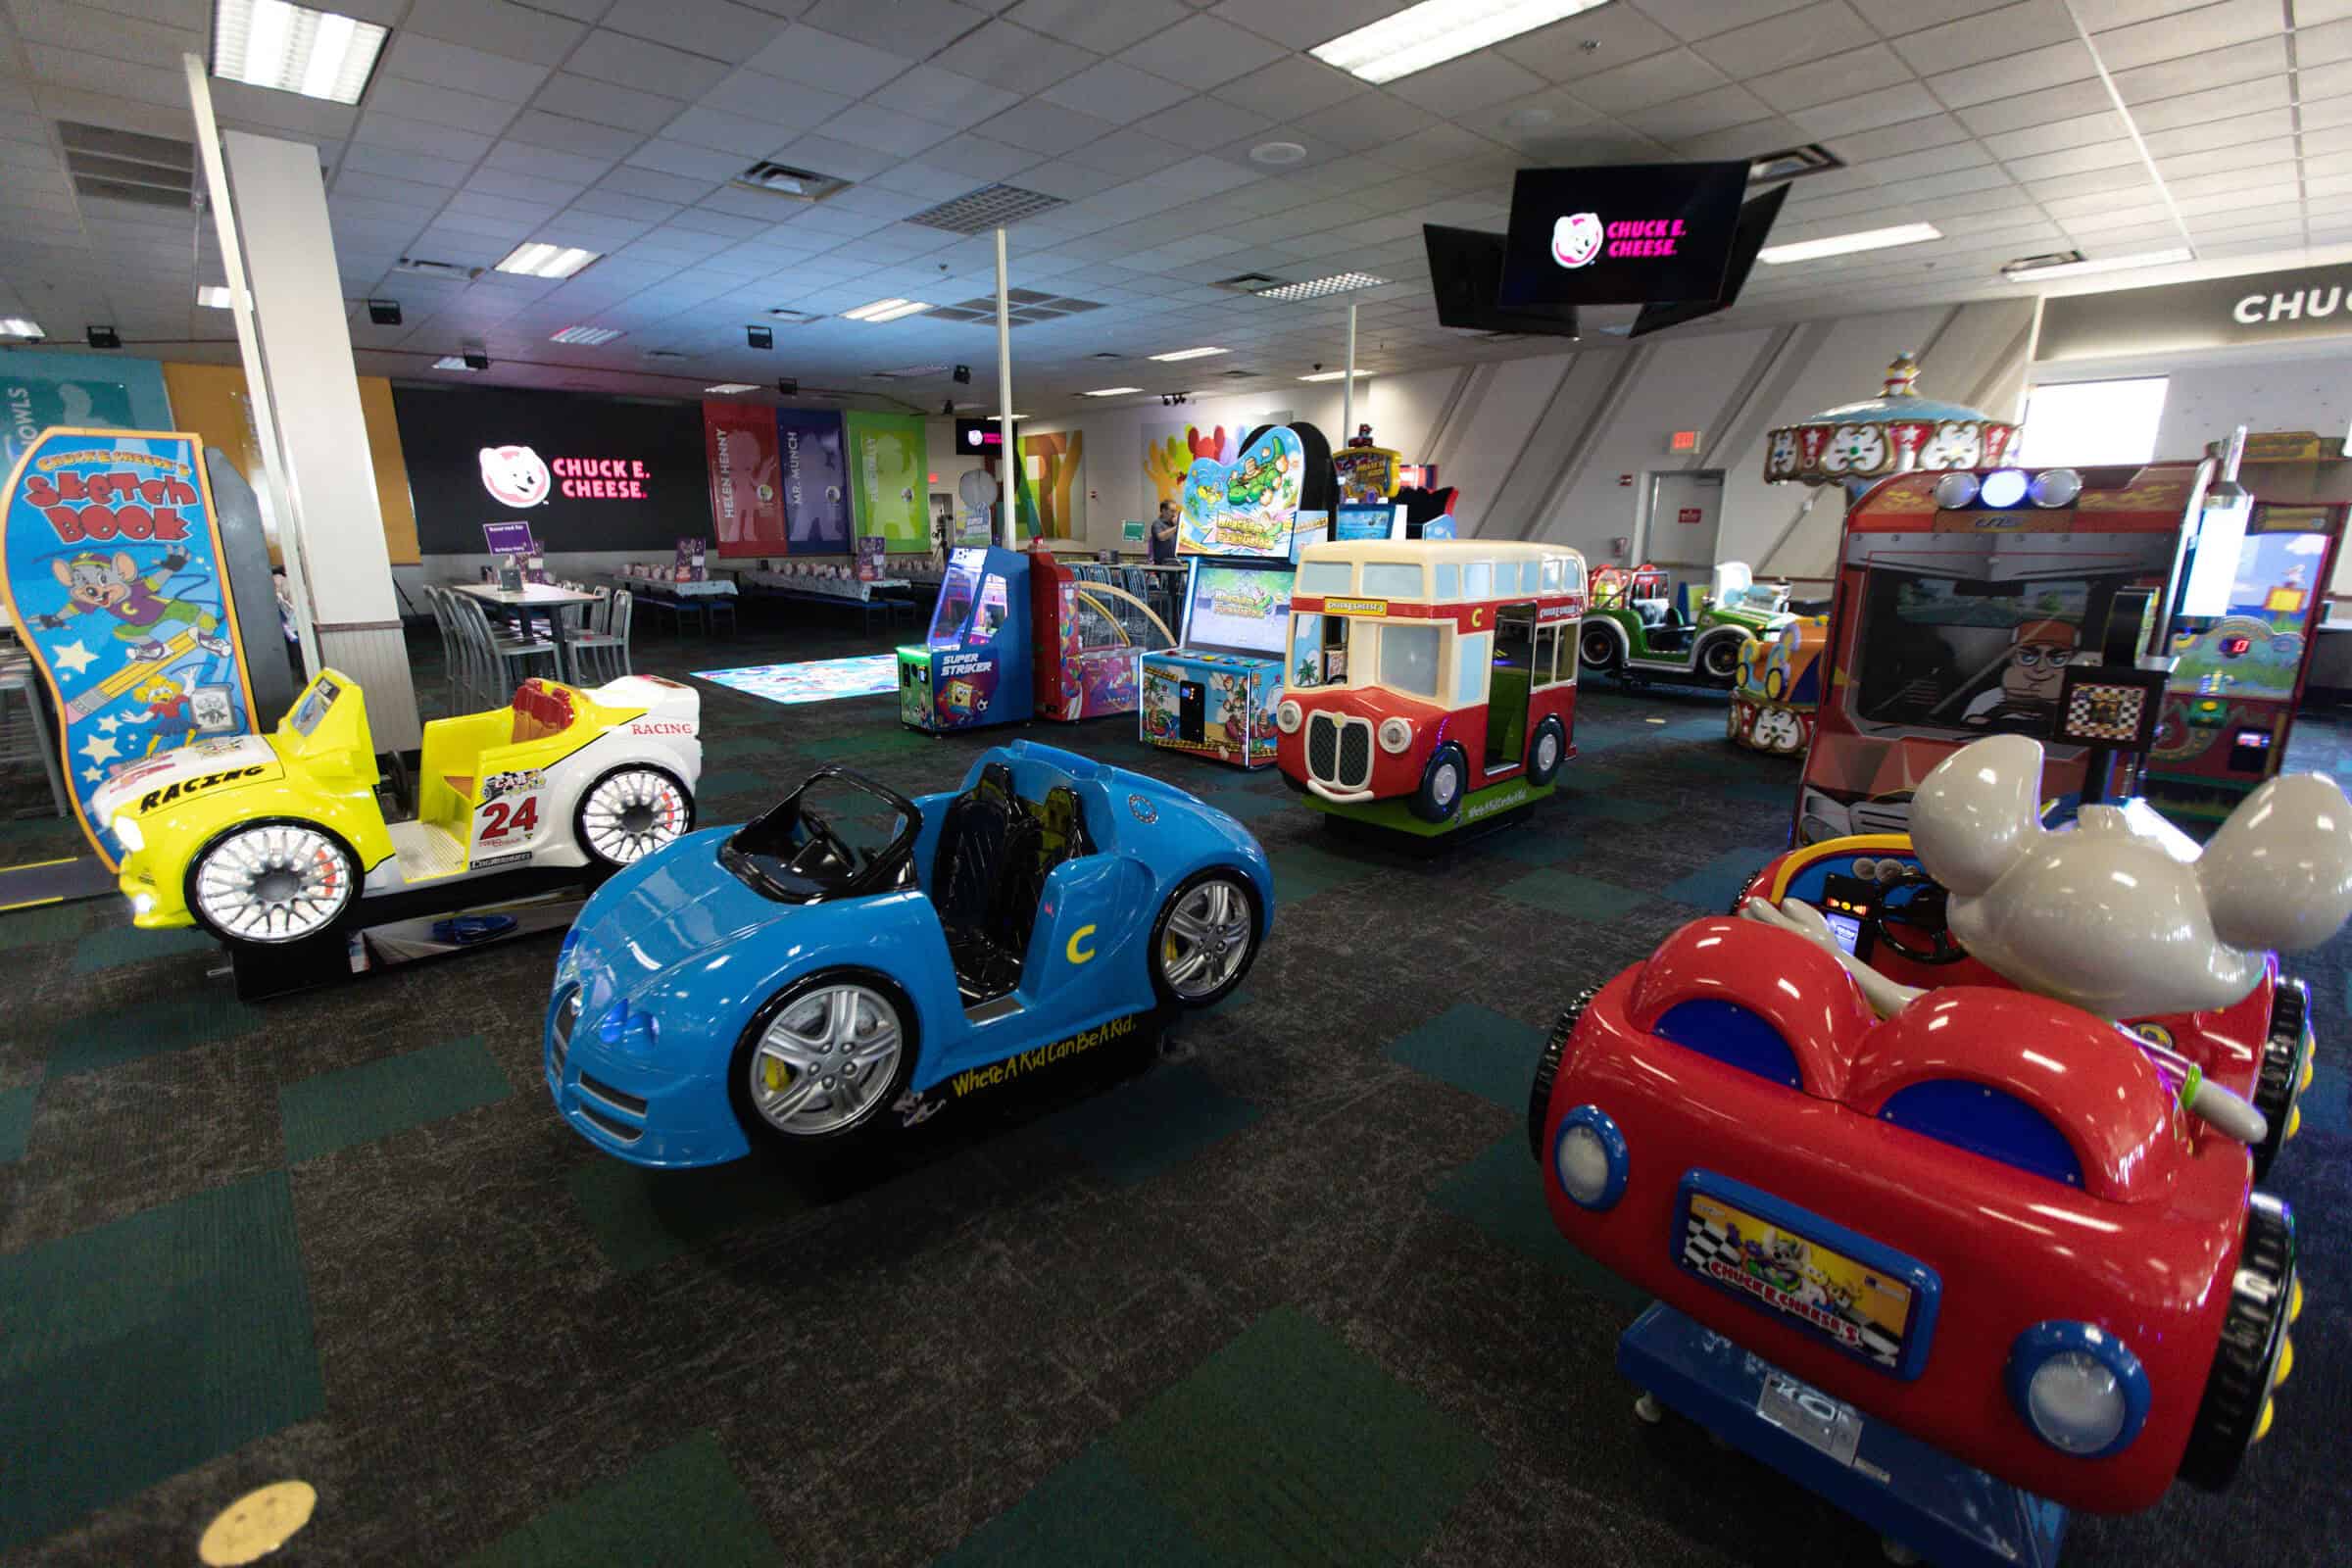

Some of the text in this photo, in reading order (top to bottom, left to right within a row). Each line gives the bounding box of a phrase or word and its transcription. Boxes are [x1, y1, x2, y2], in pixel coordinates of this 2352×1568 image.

[1607, 220, 1669, 238] CHUCK
[2232, 286, 2352, 323] CHU
[553, 458, 628, 477] CHUCK
[716, 428, 735, 518] HELEN HENNY
[787, 431, 801, 478] MUNCH
[941, 662, 992, 676] STRIKER
[943, 654, 979, 665] SUPER
[631, 723, 693, 735] RACING
[139, 765, 265, 814] RACING
[479, 797, 538, 840] 24
[1066, 924, 1097, 964] C
[952, 1066, 1004, 1098] Where
[1004, 1055, 1017, 1079] A
[1019, 1048, 1046, 1072] Kid
[1048, 1039, 1076, 1062] Can
[1076, 1032, 1099, 1054] Be
[1099, 1025, 1110, 1044] A
[1710, 1261, 1763, 1295] CHUCK
